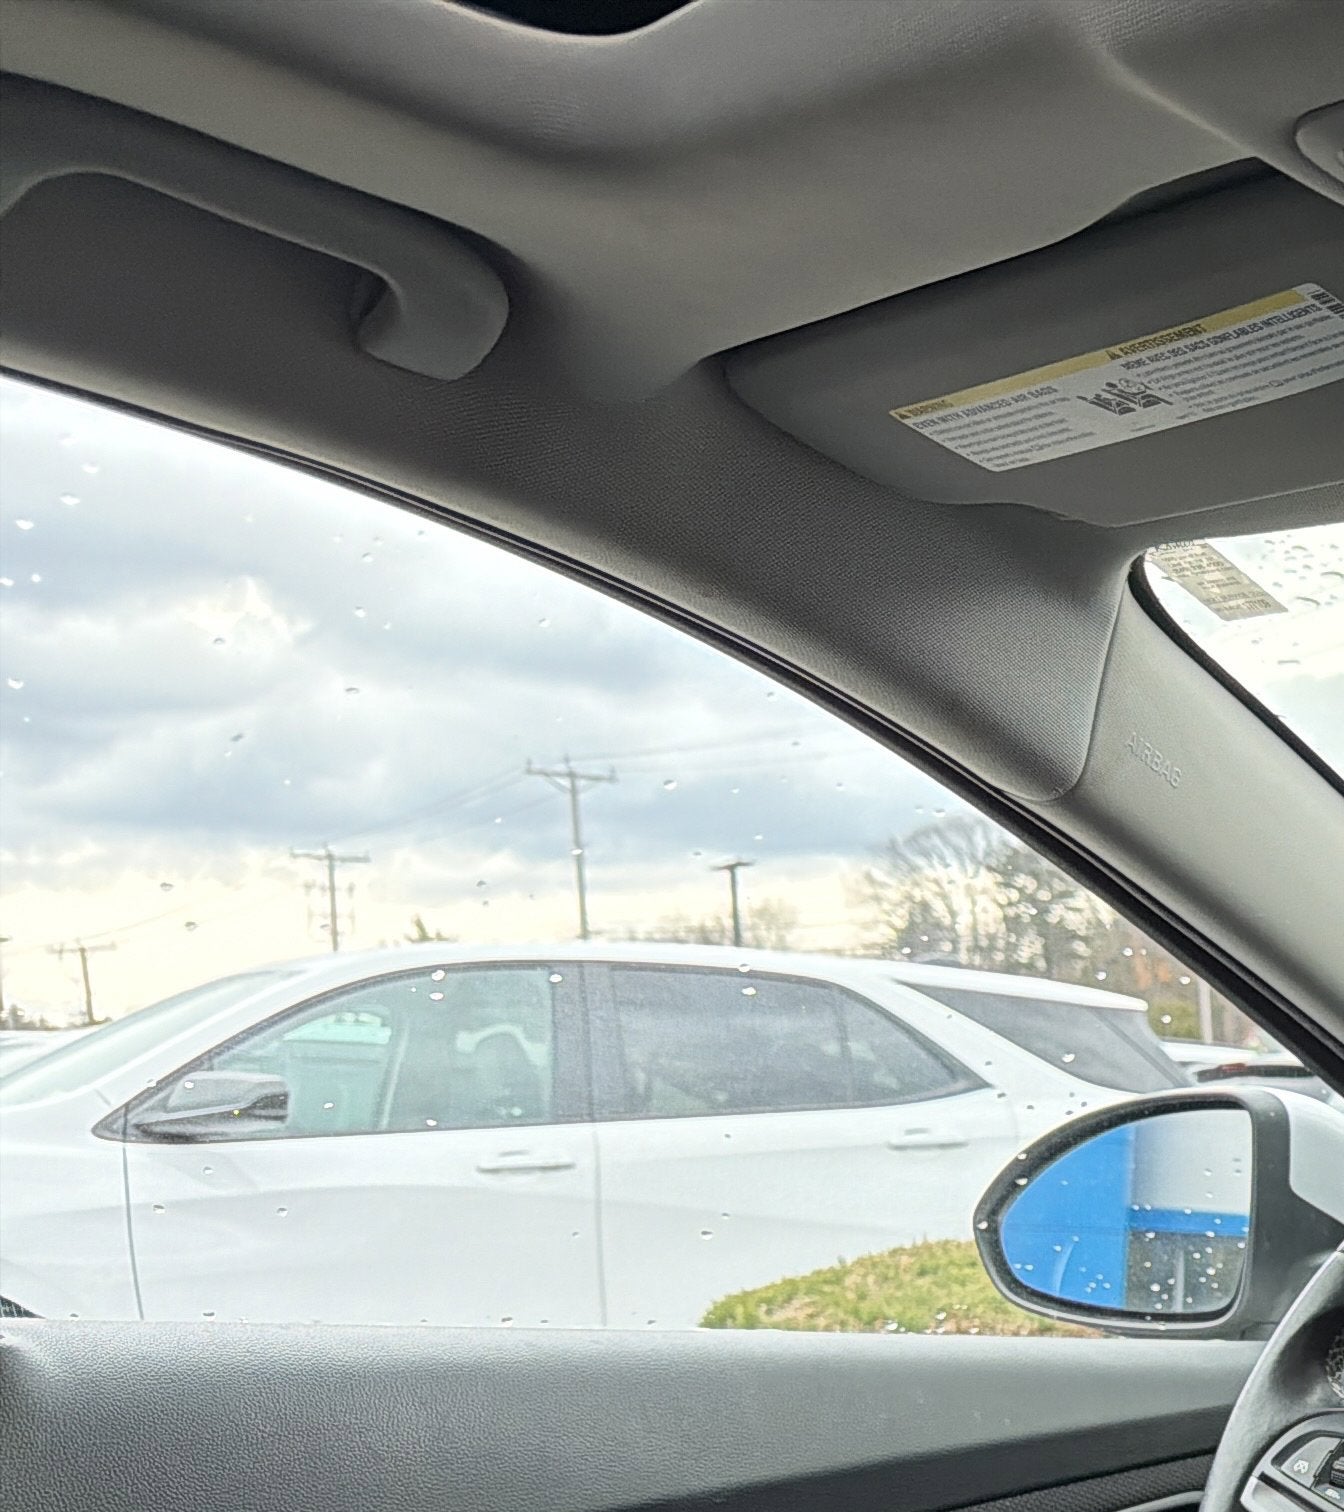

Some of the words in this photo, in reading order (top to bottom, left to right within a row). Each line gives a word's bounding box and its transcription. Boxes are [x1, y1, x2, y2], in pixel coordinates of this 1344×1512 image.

[1119, 323, 1207, 356] AVERTISSEMENT
[1207, 322, 1263, 346] GONFLABLES
[1261, 303, 1322, 330] INTELLIGENTS
[960, 398, 1012, 418] ADVANCED
[1125, 731, 1183, 789] AIRBAG
